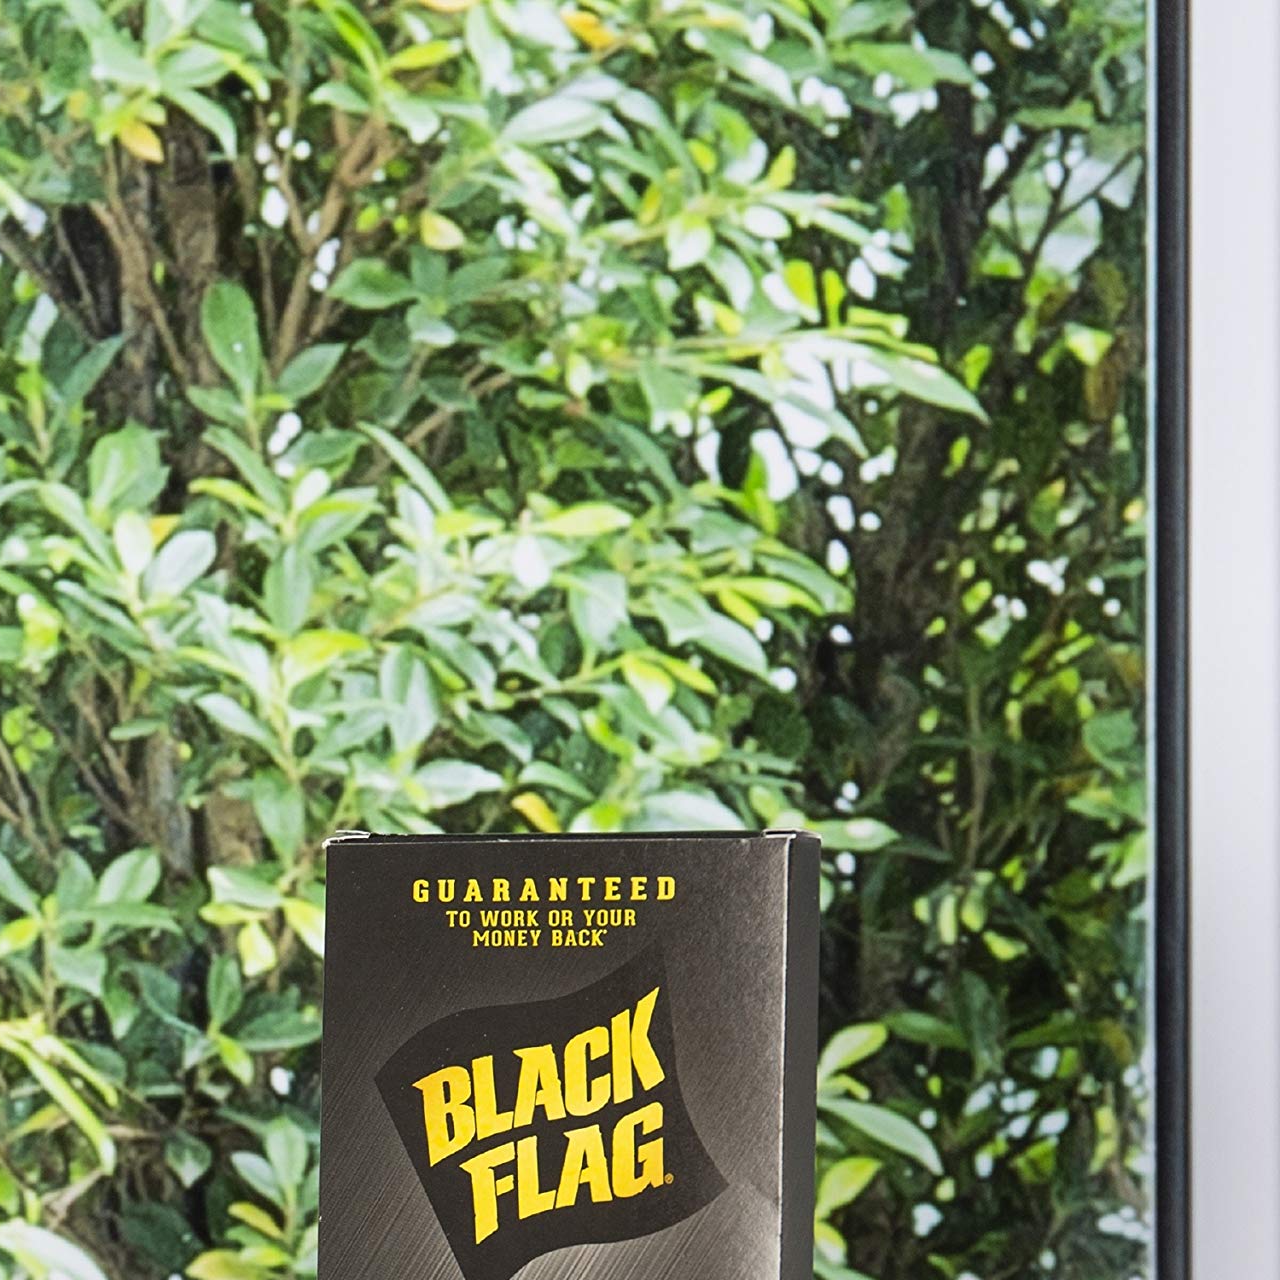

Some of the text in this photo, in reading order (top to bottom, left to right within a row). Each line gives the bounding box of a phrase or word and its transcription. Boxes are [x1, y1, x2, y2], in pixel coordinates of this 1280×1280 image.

[412, 876, 676, 903] GUARANTEED
[446, 909, 637, 927] TO WORK OR YOUR
[472, 929, 541, 947] MONEY
[412, 986, 666, 1168] BLACK
